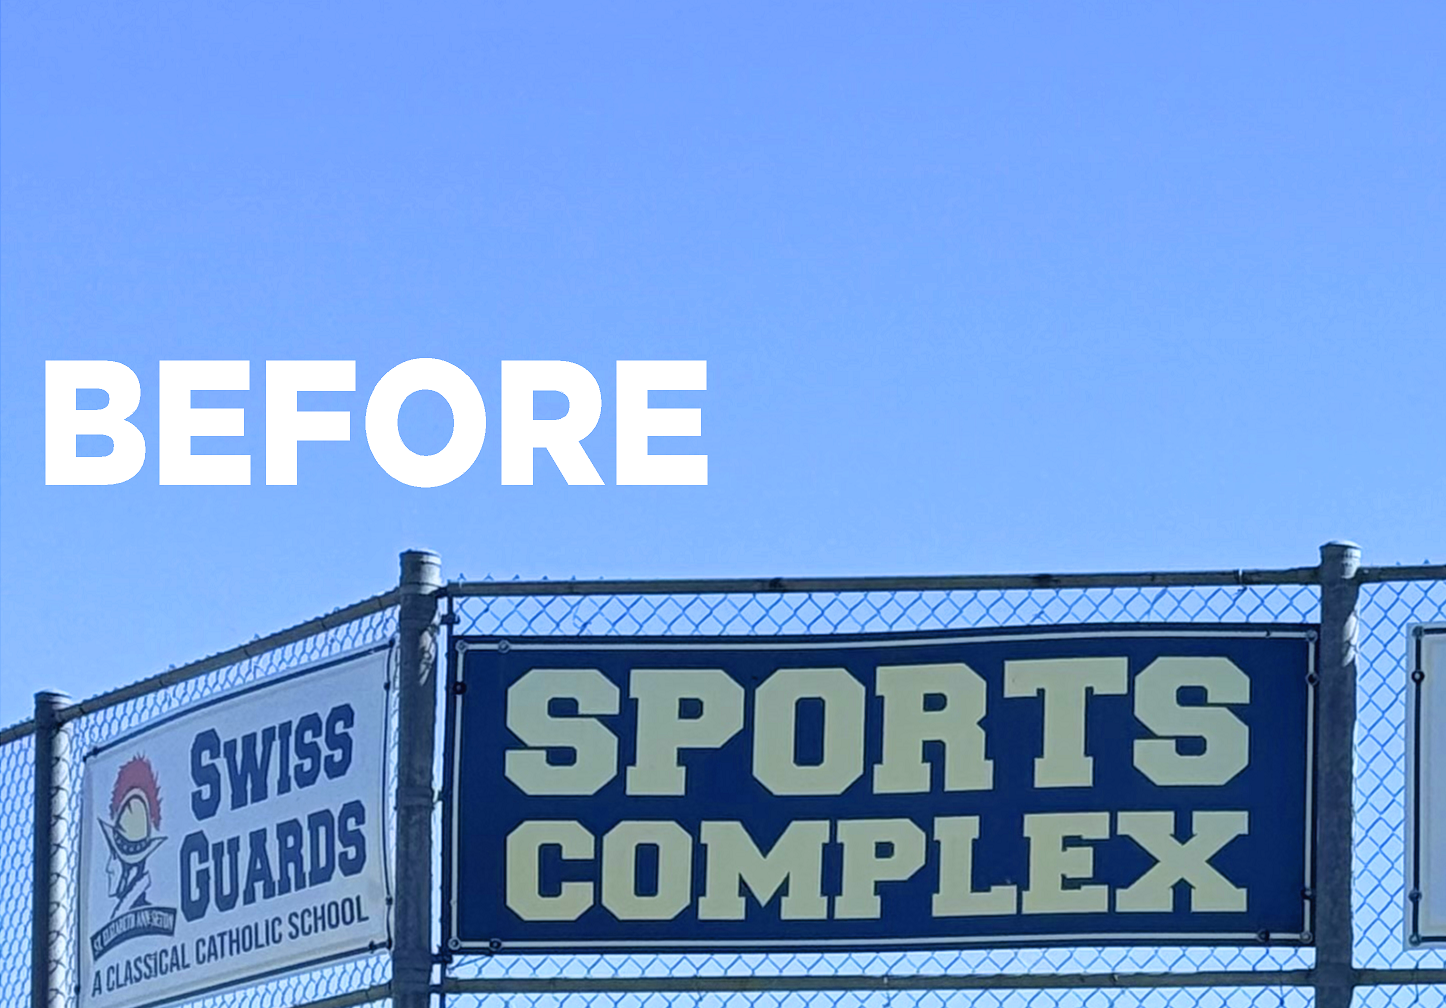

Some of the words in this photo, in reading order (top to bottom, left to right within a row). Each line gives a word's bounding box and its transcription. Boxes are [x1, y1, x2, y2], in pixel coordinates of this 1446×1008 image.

[190, 703, 355, 821] SWISS
[504, 656, 1250, 796] SPORTS
[180, 800, 366, 922] GUARDS
[504, 810, 1249, 921] COMPLEX
[92, 970, 103, 998] A
[106, 943, 190, 993] CLASSICAL
[196, 916, 282, 965] CATHOLIC
[288, 895, 370, 940] SCHOOL
